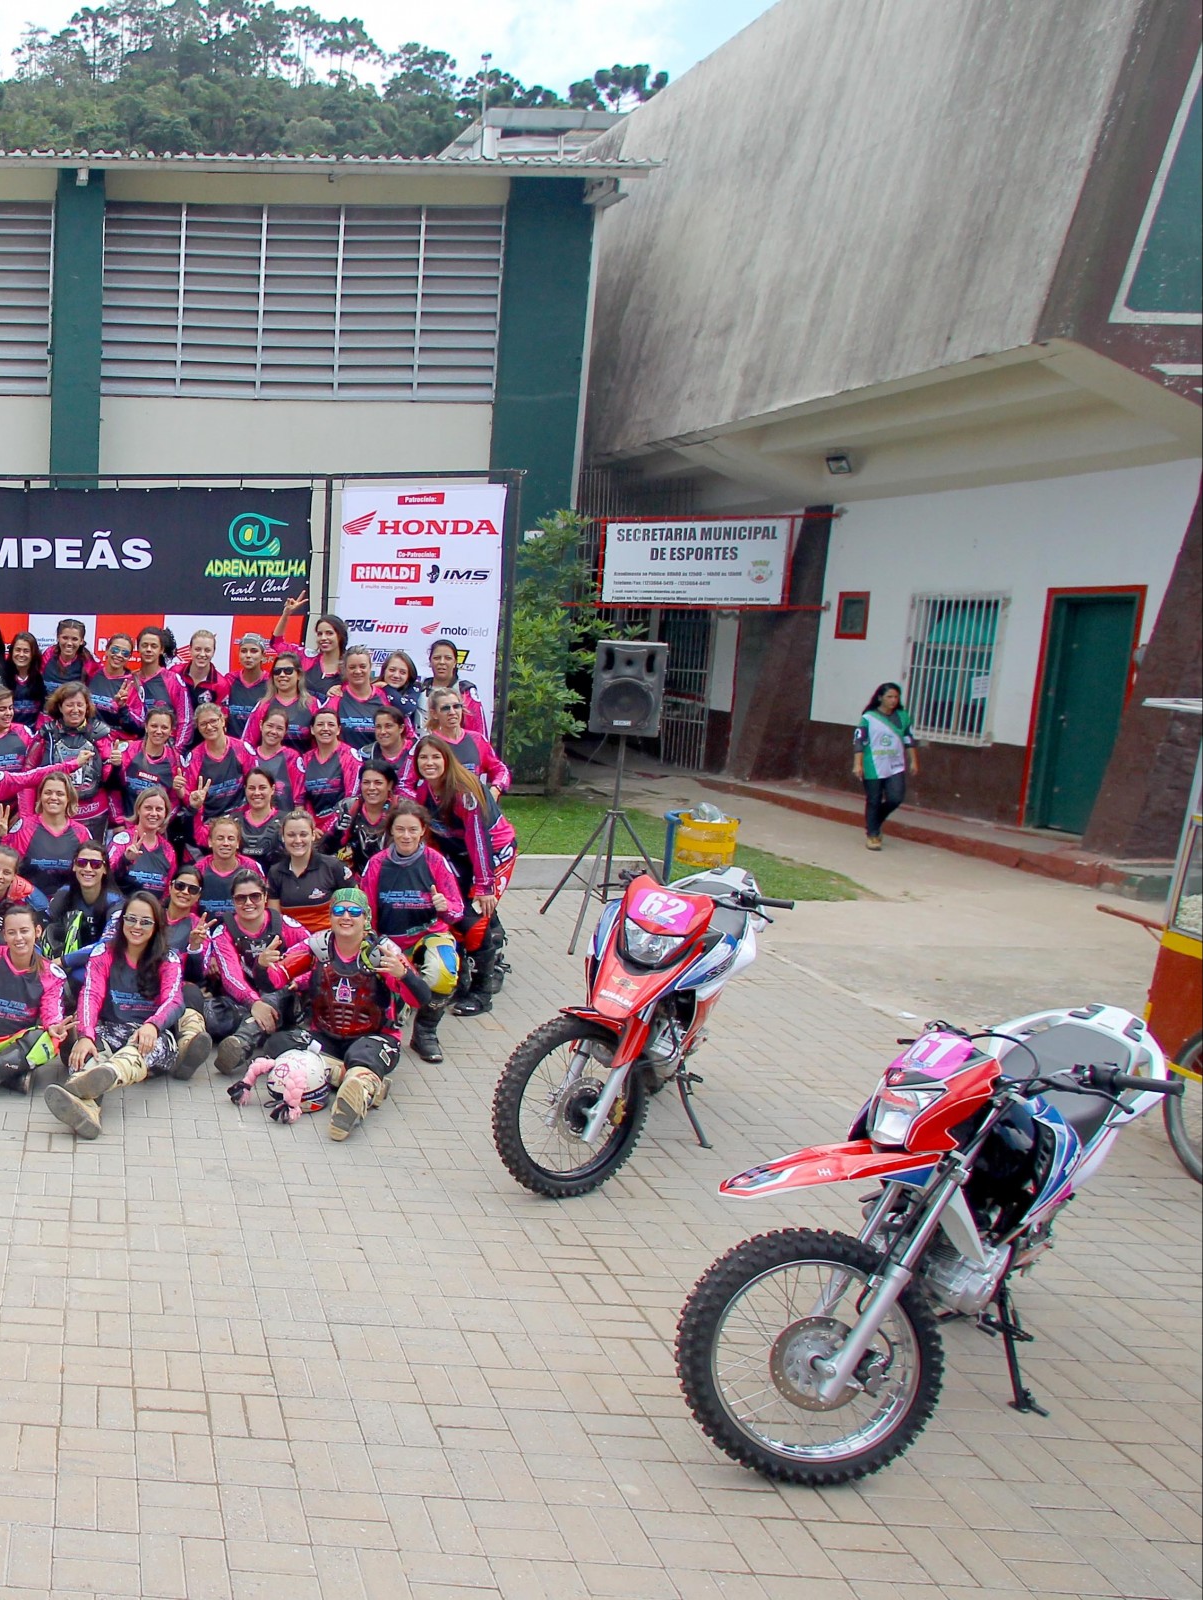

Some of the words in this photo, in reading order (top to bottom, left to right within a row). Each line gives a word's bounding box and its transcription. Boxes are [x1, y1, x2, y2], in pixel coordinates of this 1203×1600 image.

[377, 519, 499, 535] HONDA
[617, 528, 695, 542] SECRETARIA
[700, 526, 777, 541] MUNICIPAL
[650, 548, 666, 560] DE
[670, 547, 738, 560] ESPORTES
[204, 559, 307, 578] ADRENATRILHA
[222, 581, 256, 596] Trail
[261, 577, 290, 593] Club
[376, 625, 409, 634] MOTO
[441, 626, 489, 637] motofield
[639, 891, 688, 924] 62
[599, 989, 633, 1008] RINALDI
[902, 1032, 963, 1067] 61
